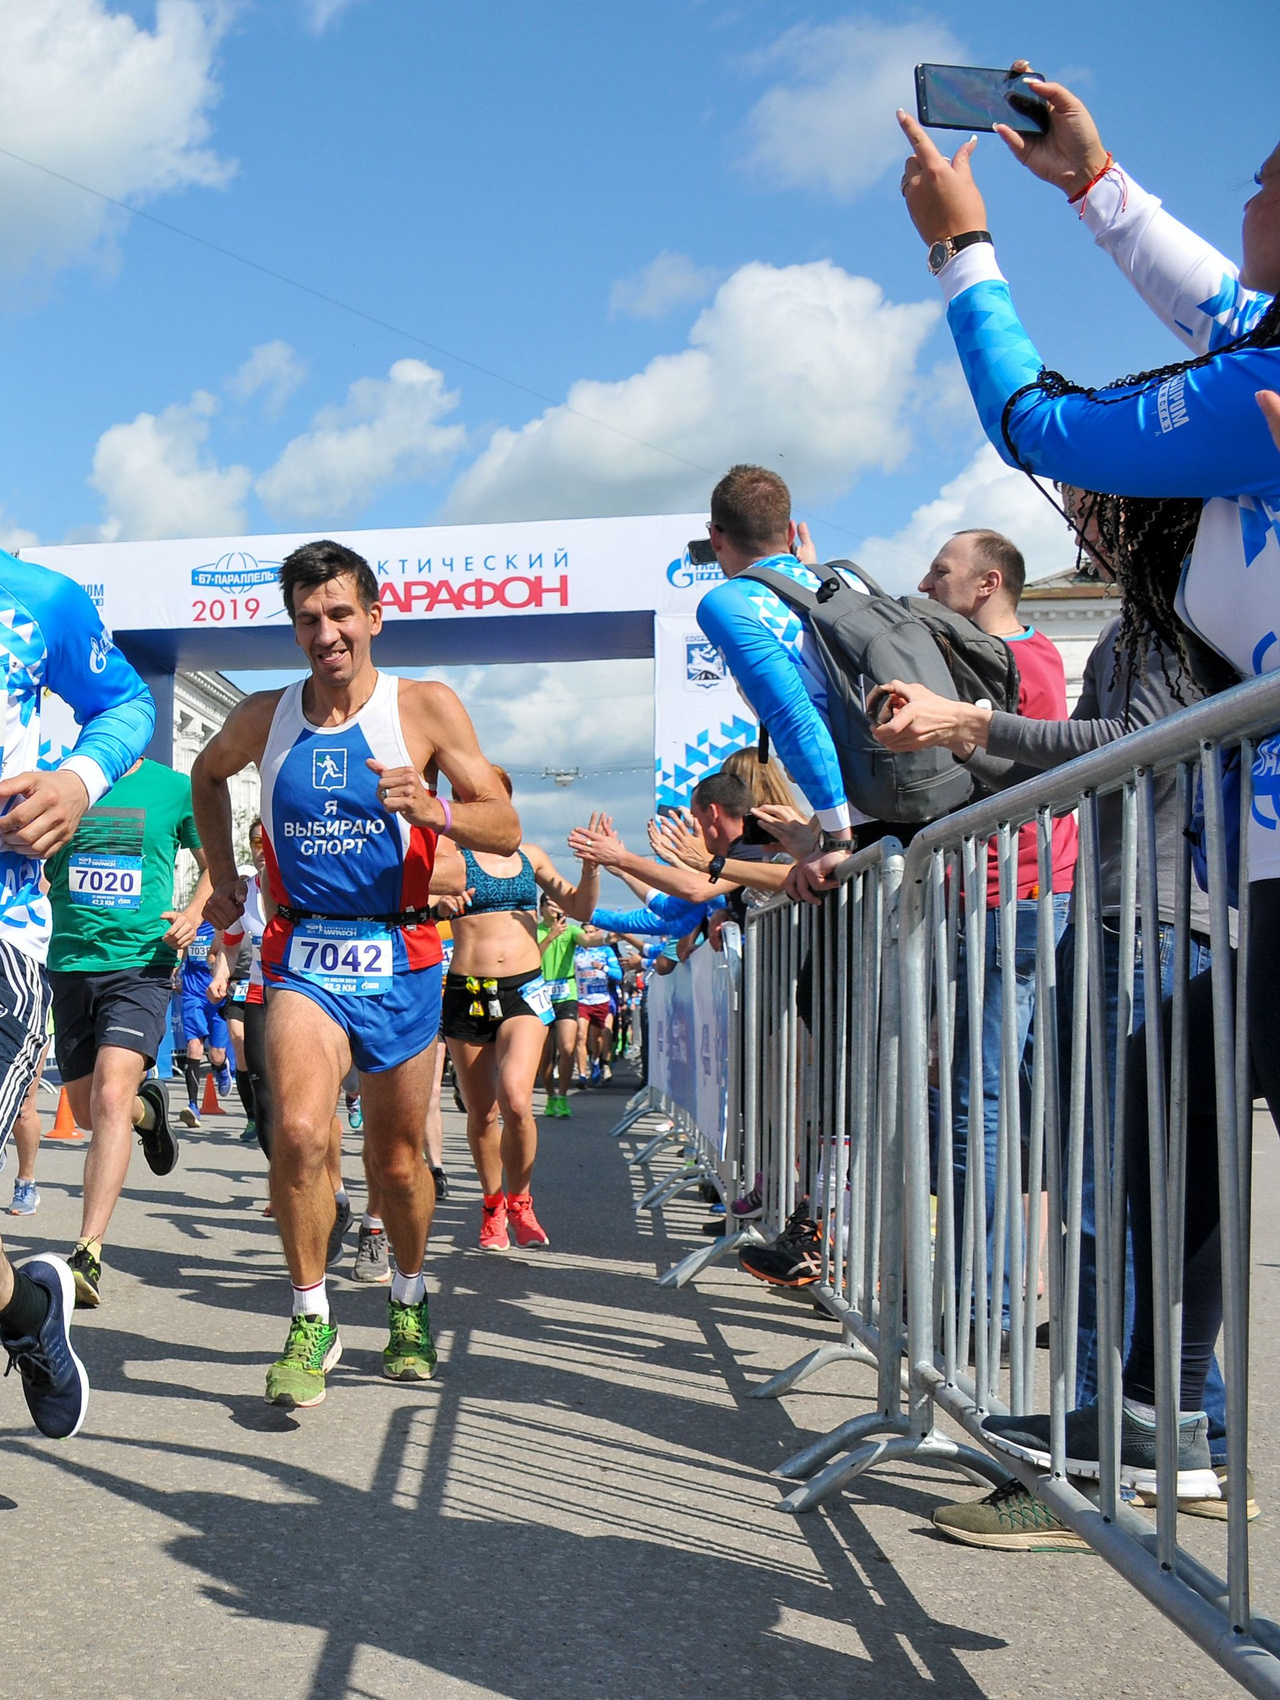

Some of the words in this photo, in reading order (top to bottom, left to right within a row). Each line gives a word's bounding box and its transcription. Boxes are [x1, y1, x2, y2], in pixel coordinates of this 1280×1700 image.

[1168, 373, 1189, 428] ЗПРОМ
[377, 548, 569, 575] КТИЧЕСКИЙ
[378, 575, 568, 612] АРАФОН
[192, 598, 260, 621] 2019
[323, 800, 338, 815] Я
[284, 818, 386, 837] ВЫБИРАЮ
[300, 838, 367, 856] СПОРТ
[76, 870, 134, 892] 7020
[300, 941, 382, 973] 7042
